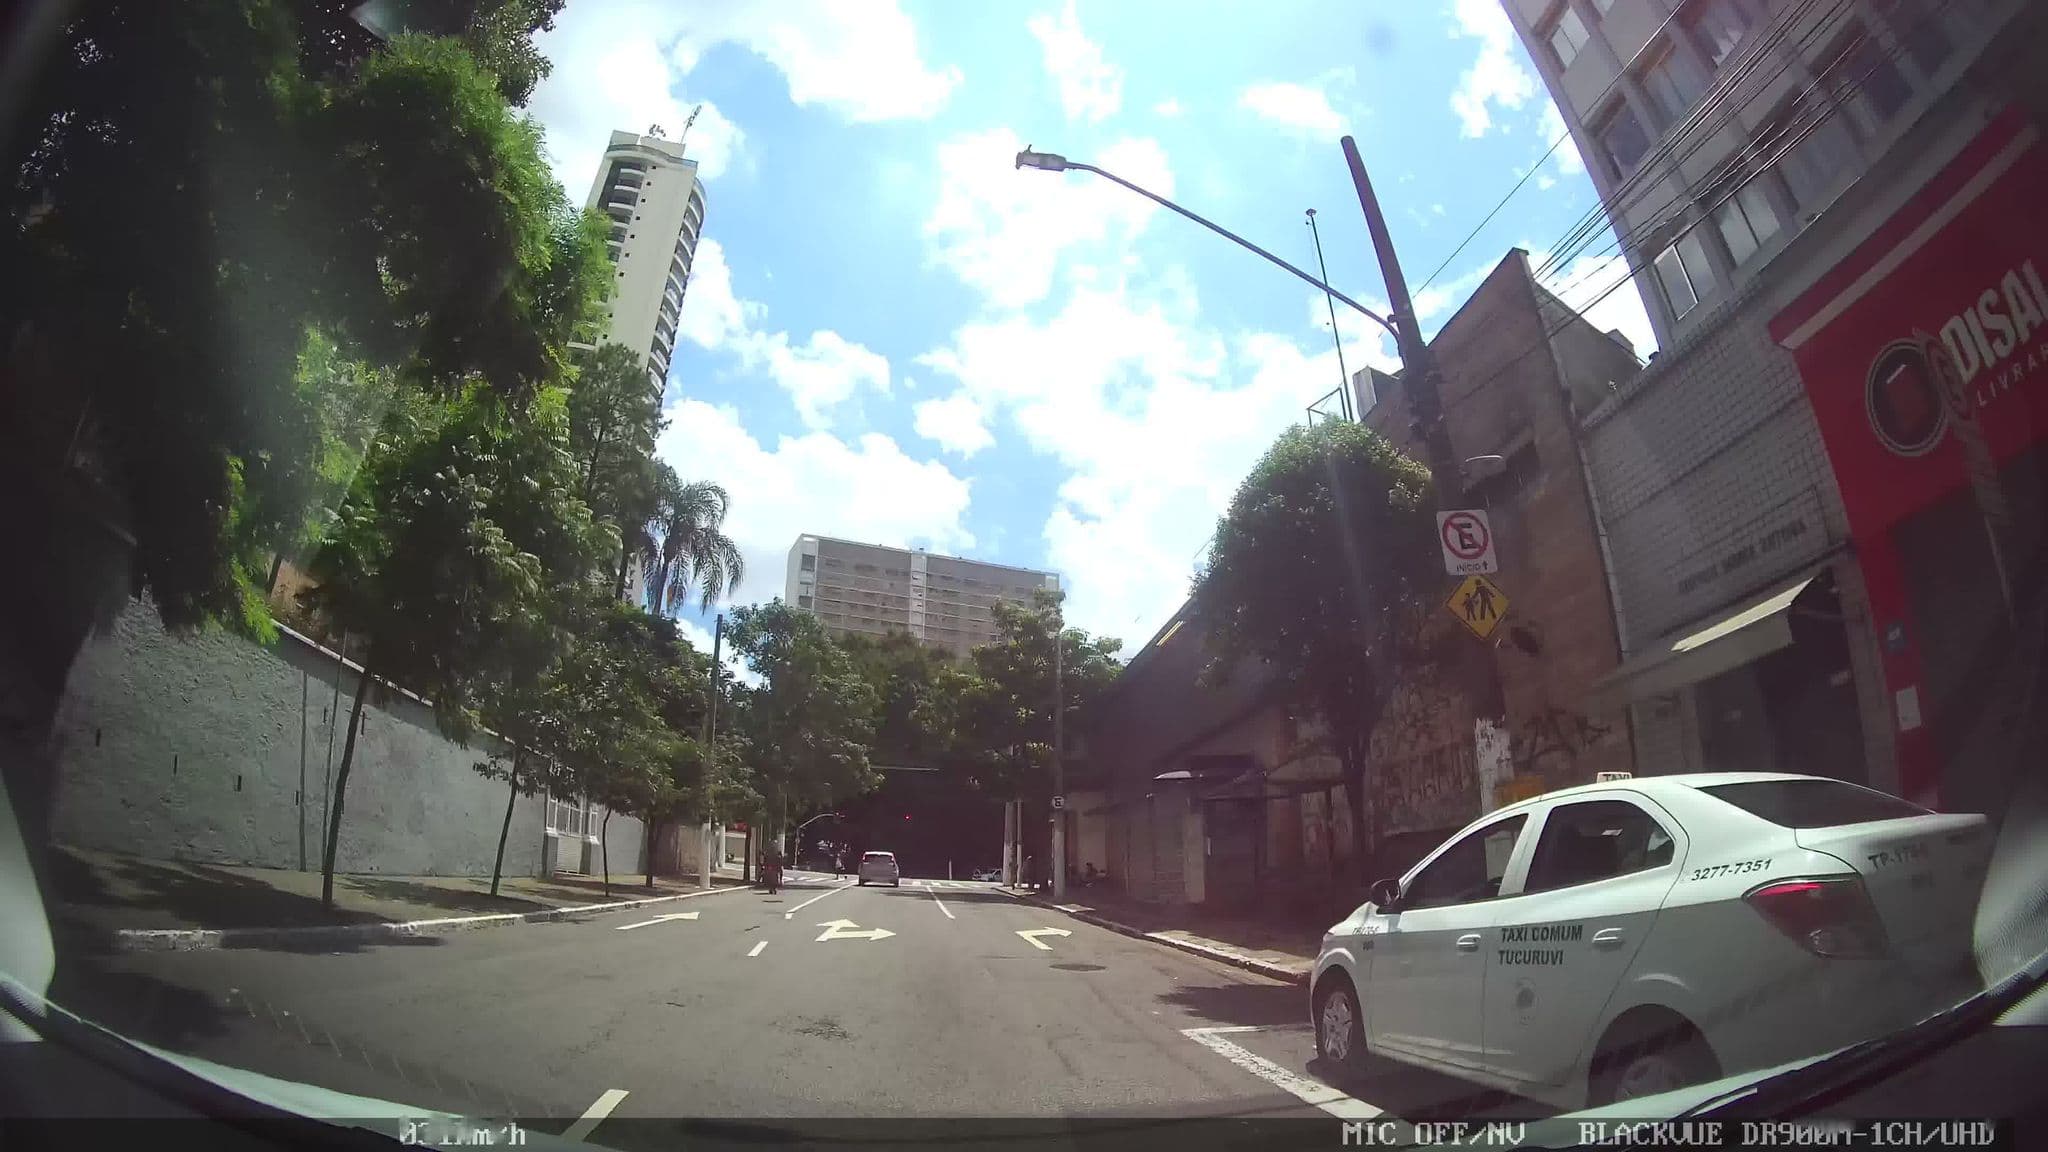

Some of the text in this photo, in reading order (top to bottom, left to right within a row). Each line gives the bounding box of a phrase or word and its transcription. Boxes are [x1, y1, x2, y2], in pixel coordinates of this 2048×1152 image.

[1691, 859, 1772, 881] 3277-7351
[1500, 925, 1584, 943] TAXI COMUM
[1497, 949, 1564, 966] TUCURUVI
